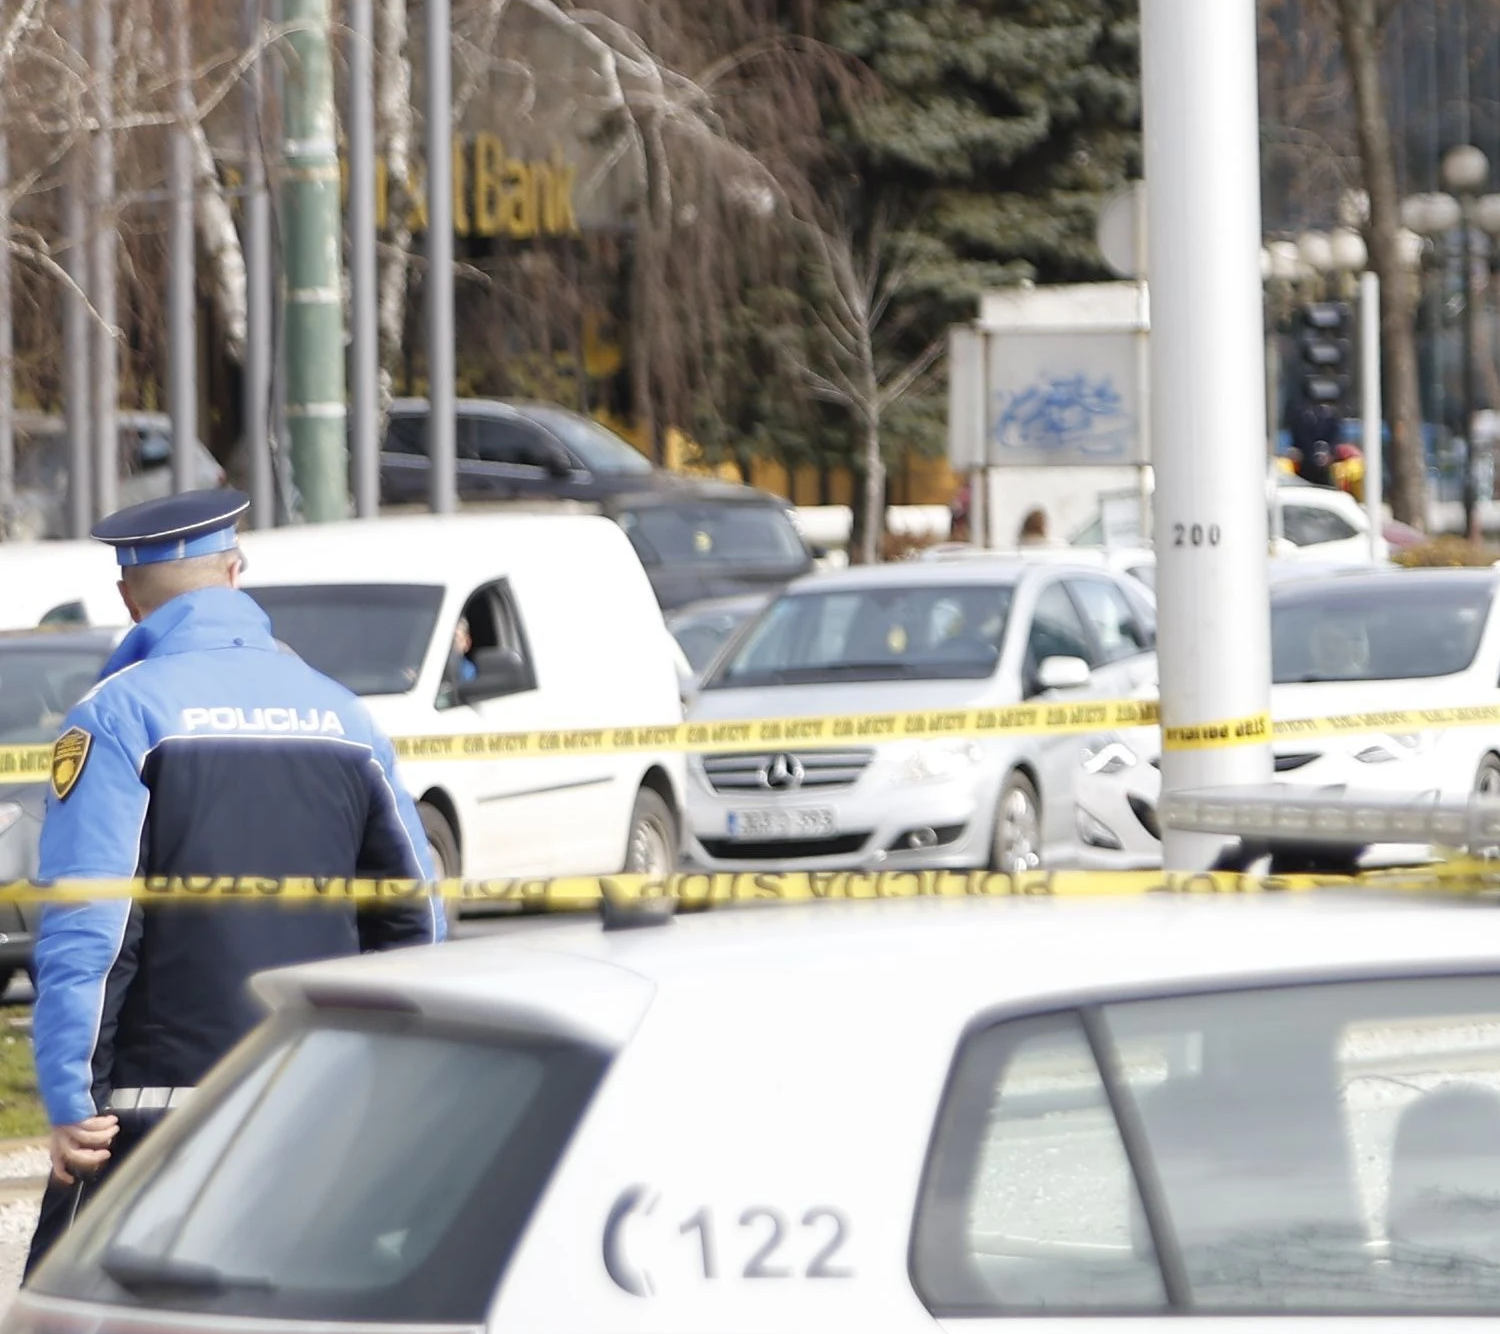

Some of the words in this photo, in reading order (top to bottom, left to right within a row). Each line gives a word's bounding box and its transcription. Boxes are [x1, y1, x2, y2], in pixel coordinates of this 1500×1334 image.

[476, 131, 582, 238] Bank
[1173, 523, 1221, 548] 200
[183, 706, 345, 736] POLICIJA
[677, 1203, 858, 1279] 122
